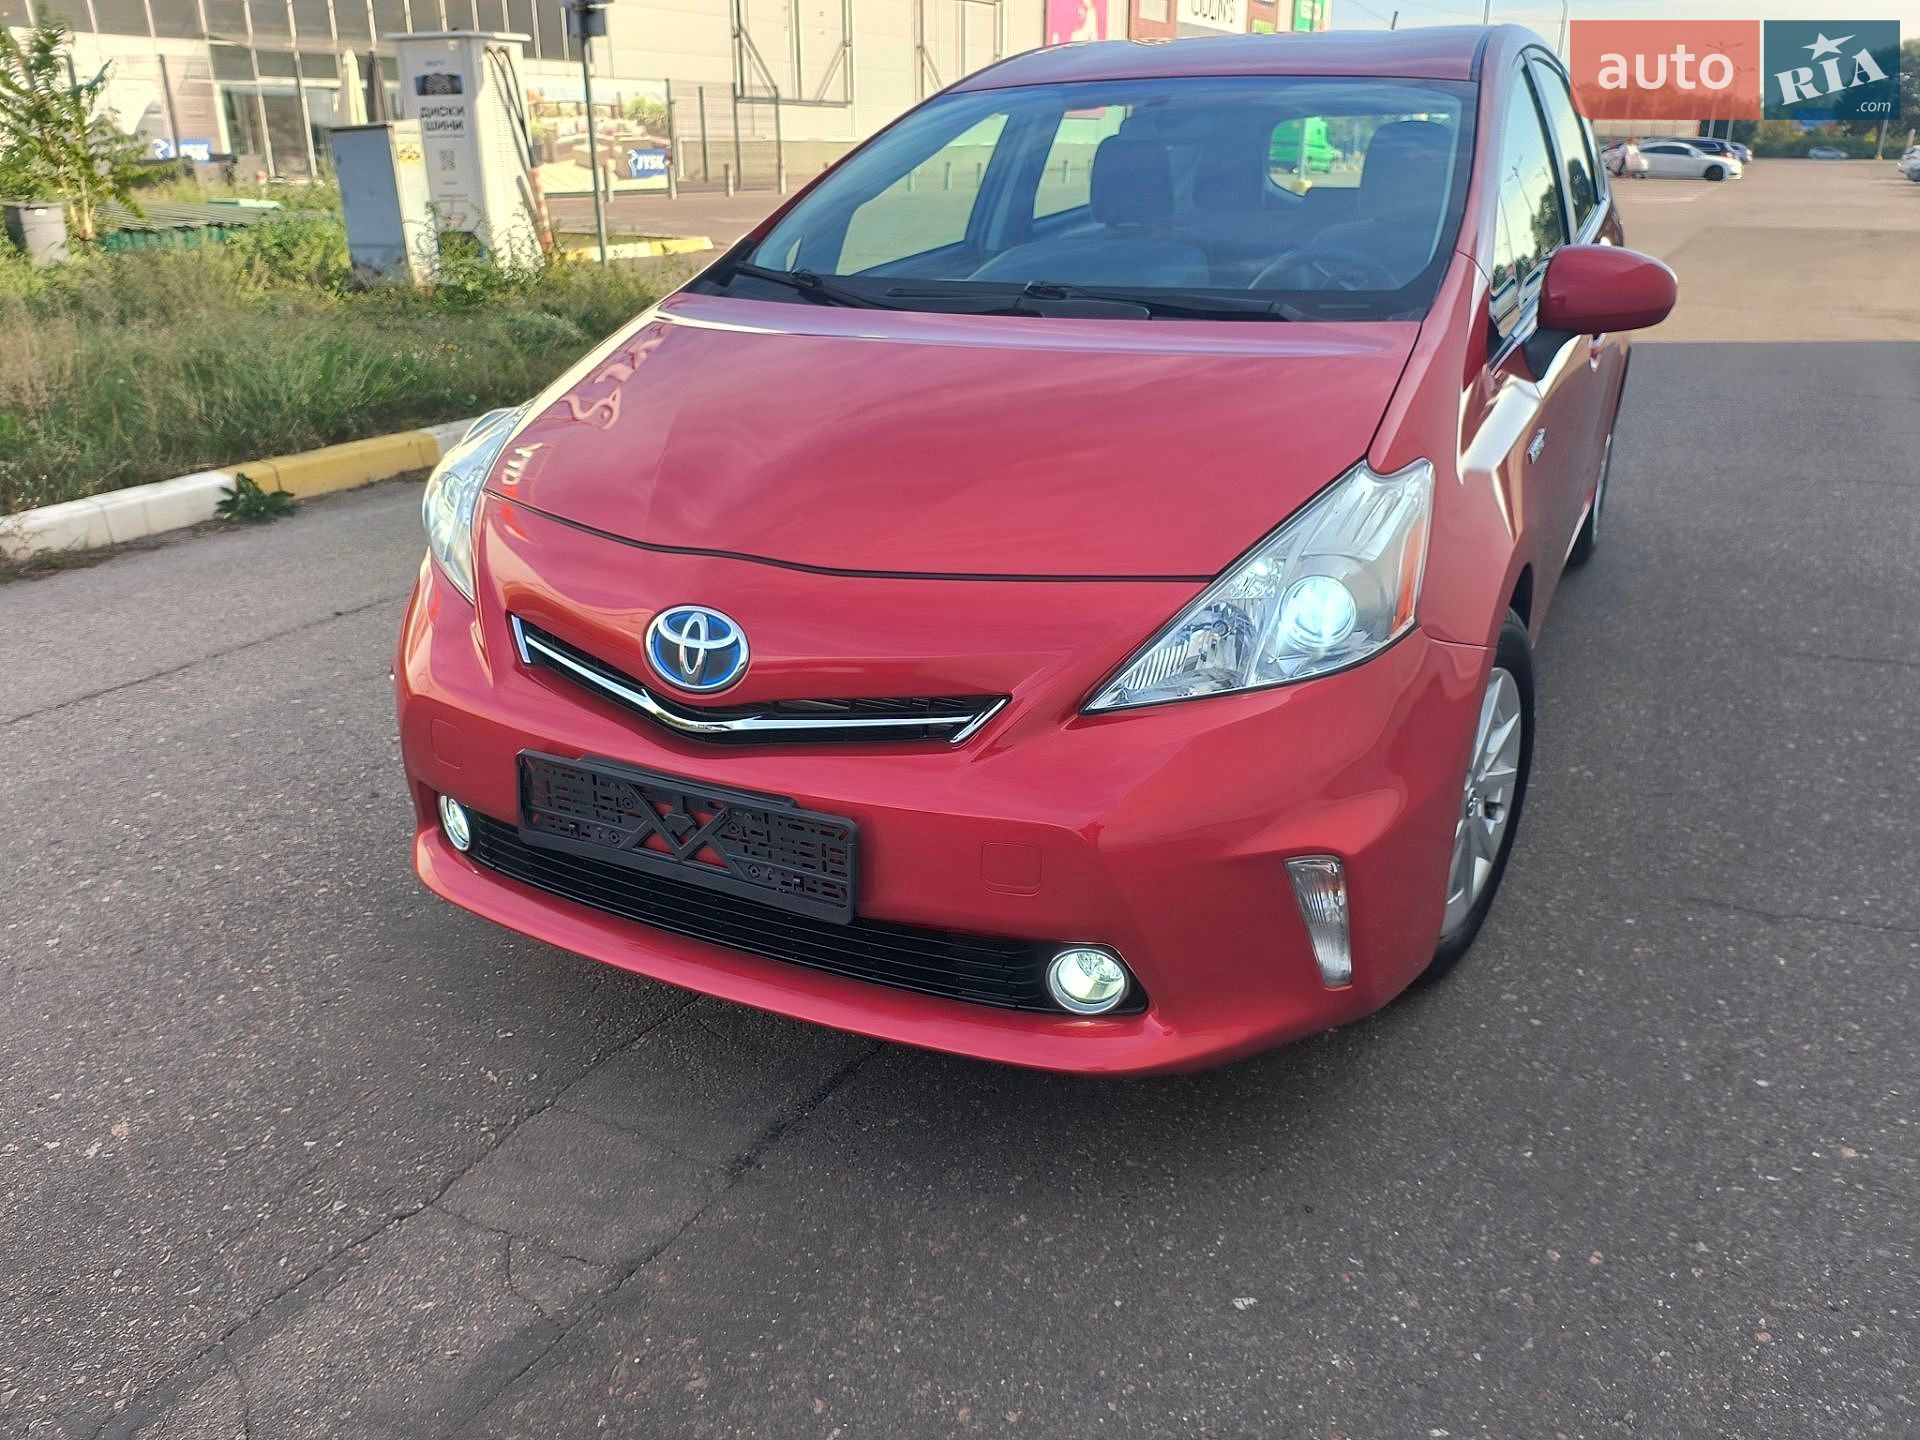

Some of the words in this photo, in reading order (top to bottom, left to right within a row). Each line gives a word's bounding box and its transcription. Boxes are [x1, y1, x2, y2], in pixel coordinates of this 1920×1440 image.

[420, 105, 465, 118] ДИСКИ
[424, 119, 465, 131] ШИНИ
[636, 154, 665, 171] JYSK
